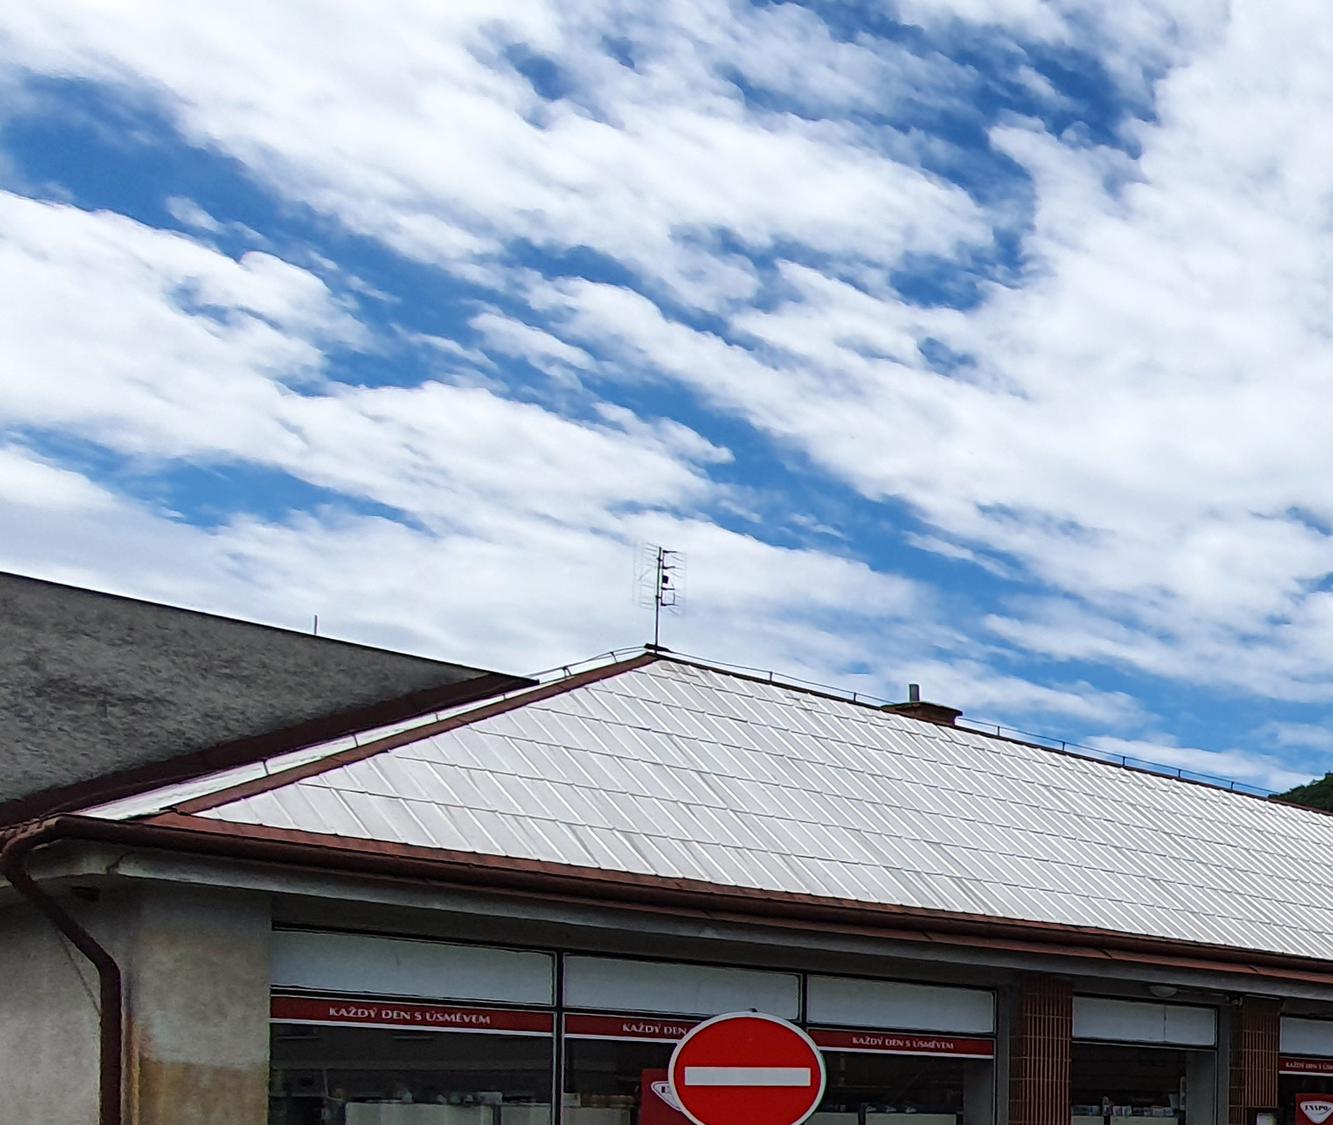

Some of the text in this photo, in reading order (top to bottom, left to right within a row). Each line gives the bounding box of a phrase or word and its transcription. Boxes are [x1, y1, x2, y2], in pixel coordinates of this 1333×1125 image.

[329, 1006, 491, 1024] KAŽDÝ DEN S ÚSMĚVEM
[622, 1022, 687, 1035] KAŽDÝ DEN
[851, 1036, 883, 1046] KAŽDÝ
[885, 1038, 904, 1047] DEN
